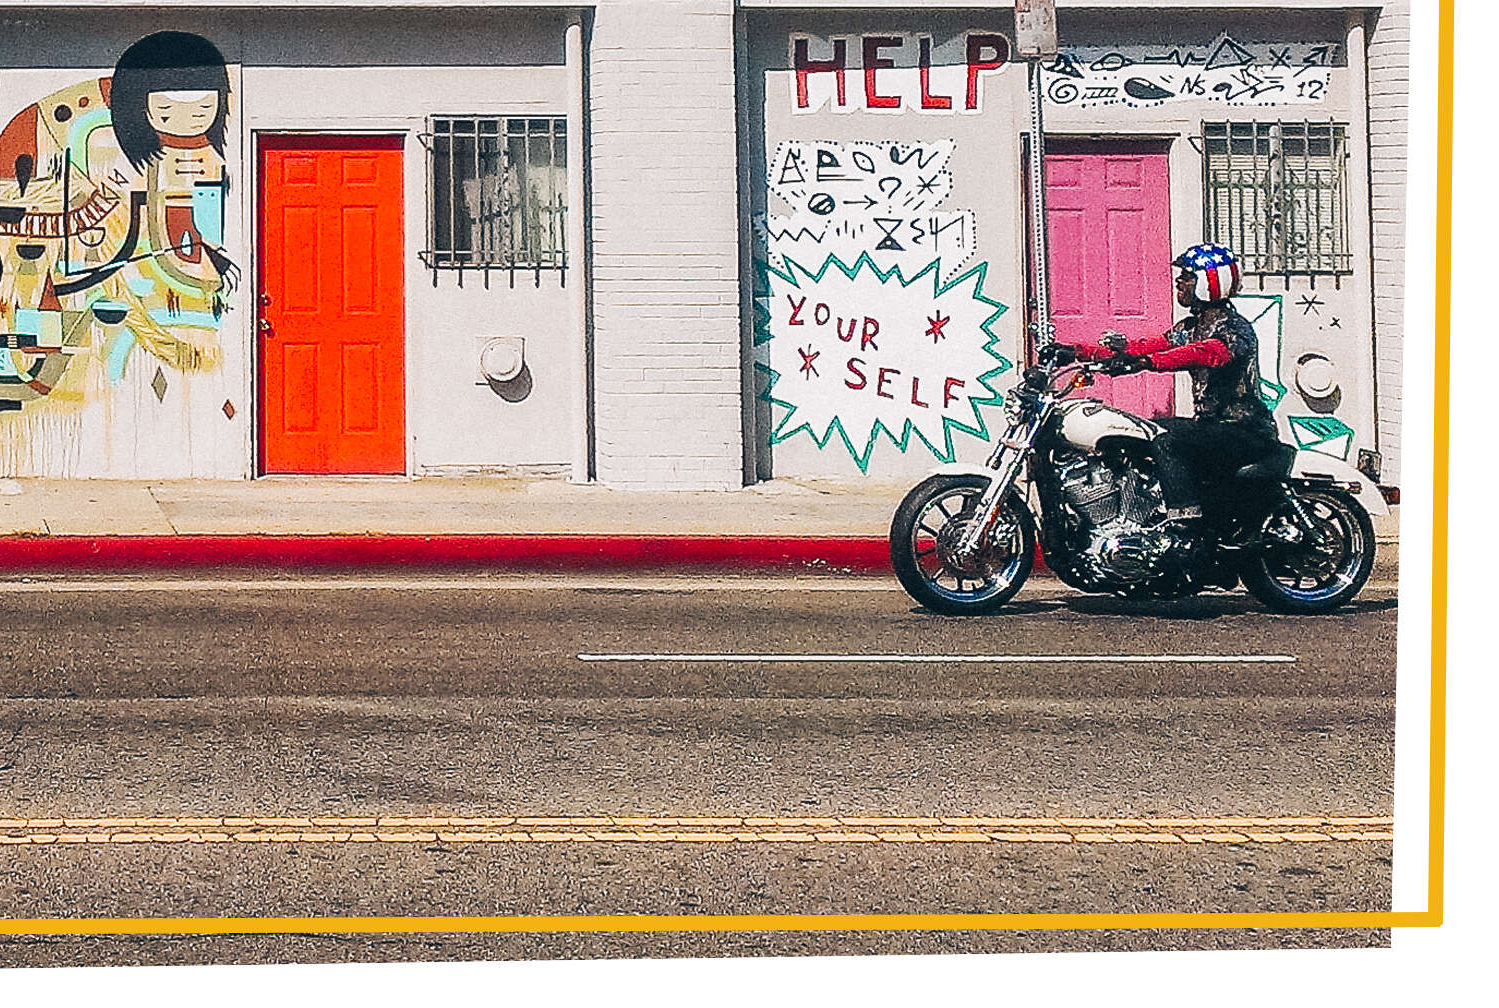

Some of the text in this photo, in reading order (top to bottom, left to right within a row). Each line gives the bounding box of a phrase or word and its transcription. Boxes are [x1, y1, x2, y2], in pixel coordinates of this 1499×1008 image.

[793, 33, 1011, 110] HELP
[787, 294, 880, 351] YOUR
[844, 357, 966, 408] SELF
